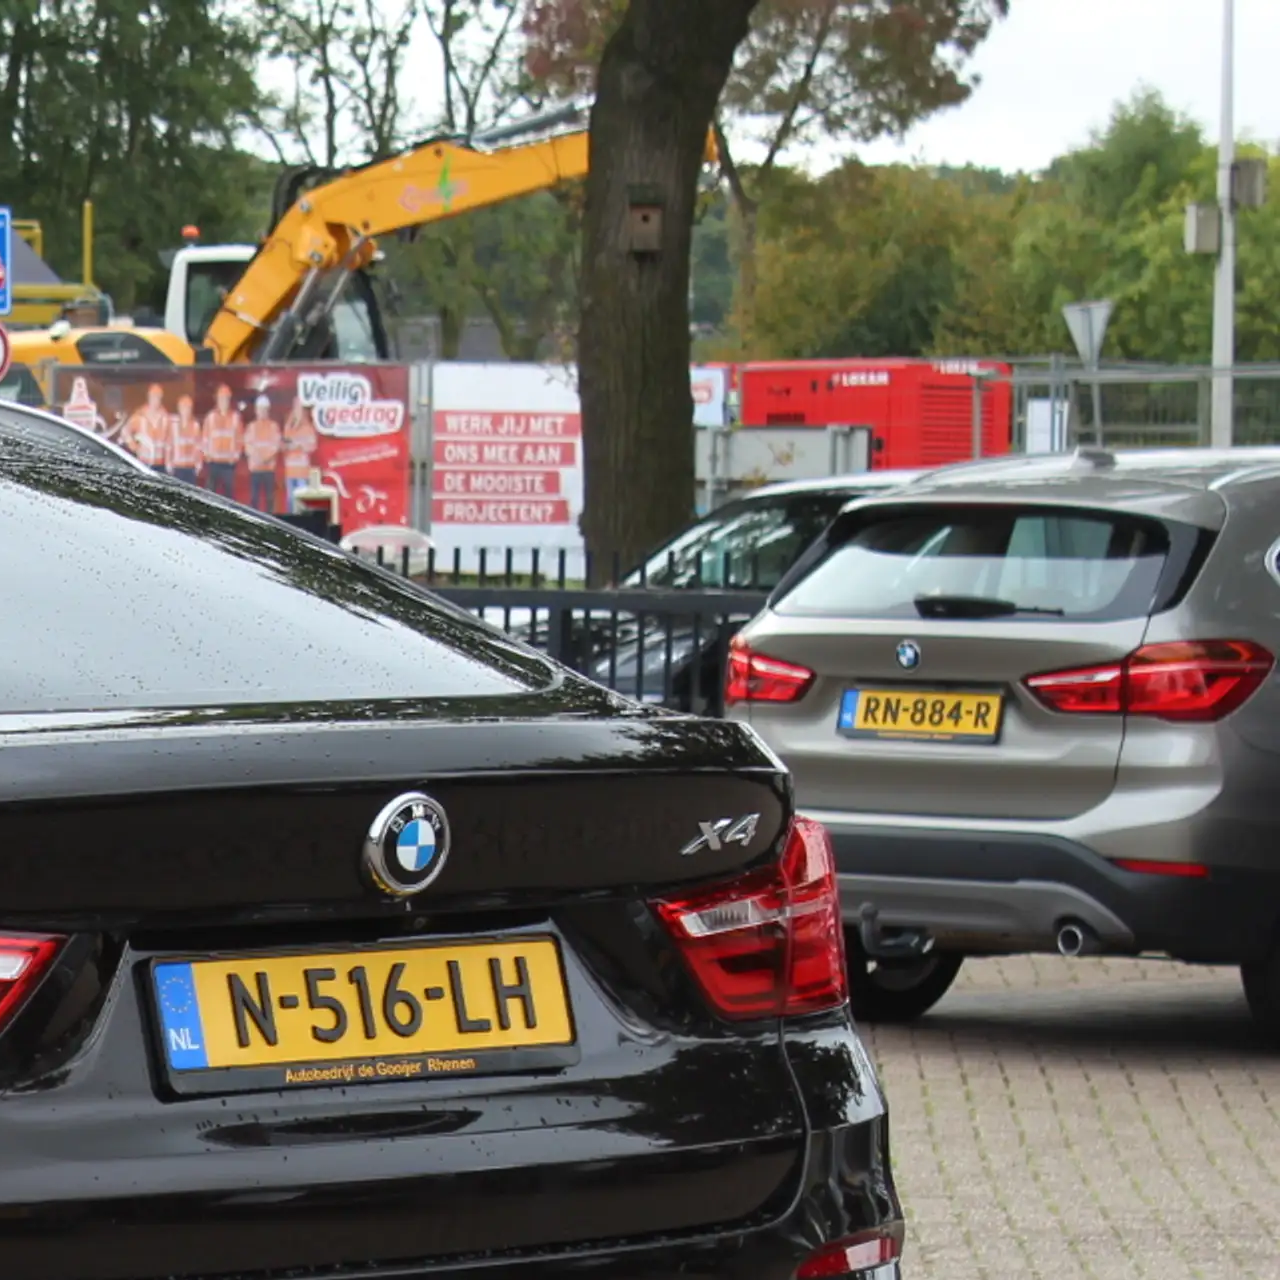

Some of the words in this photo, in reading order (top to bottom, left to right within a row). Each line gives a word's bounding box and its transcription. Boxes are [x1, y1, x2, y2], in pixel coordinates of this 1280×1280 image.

[302, 380, 366, 404] Veilig
[326, 404, 398, 427] gedrag
[445, 414, 493, 433] WERK
[497, 415, 526, 434] JIJ
[529, 416, 565, 434] MET
[444, 443, 478, 463] ONS
[483, 444, 519, 463] MEE
[523, 445, 561, 464] AAN
[444, 472, 465, 492] DE
[470, 473, 545, 493] MOOISTE
[443, 502, 554, 522] PROJECTEN?
[863, 697, 991, 728] RN-884-R
[680, 812, 760, 855] X4
[227, 956, 537, 1048] N-516-LH
[169, 1028, 200, 1052] NL
[285, 1064, 354, 1083] Autobedrijf
[358, 1064, 375, 1078] de
[427, 1057, 475, 1072] Rhenen
